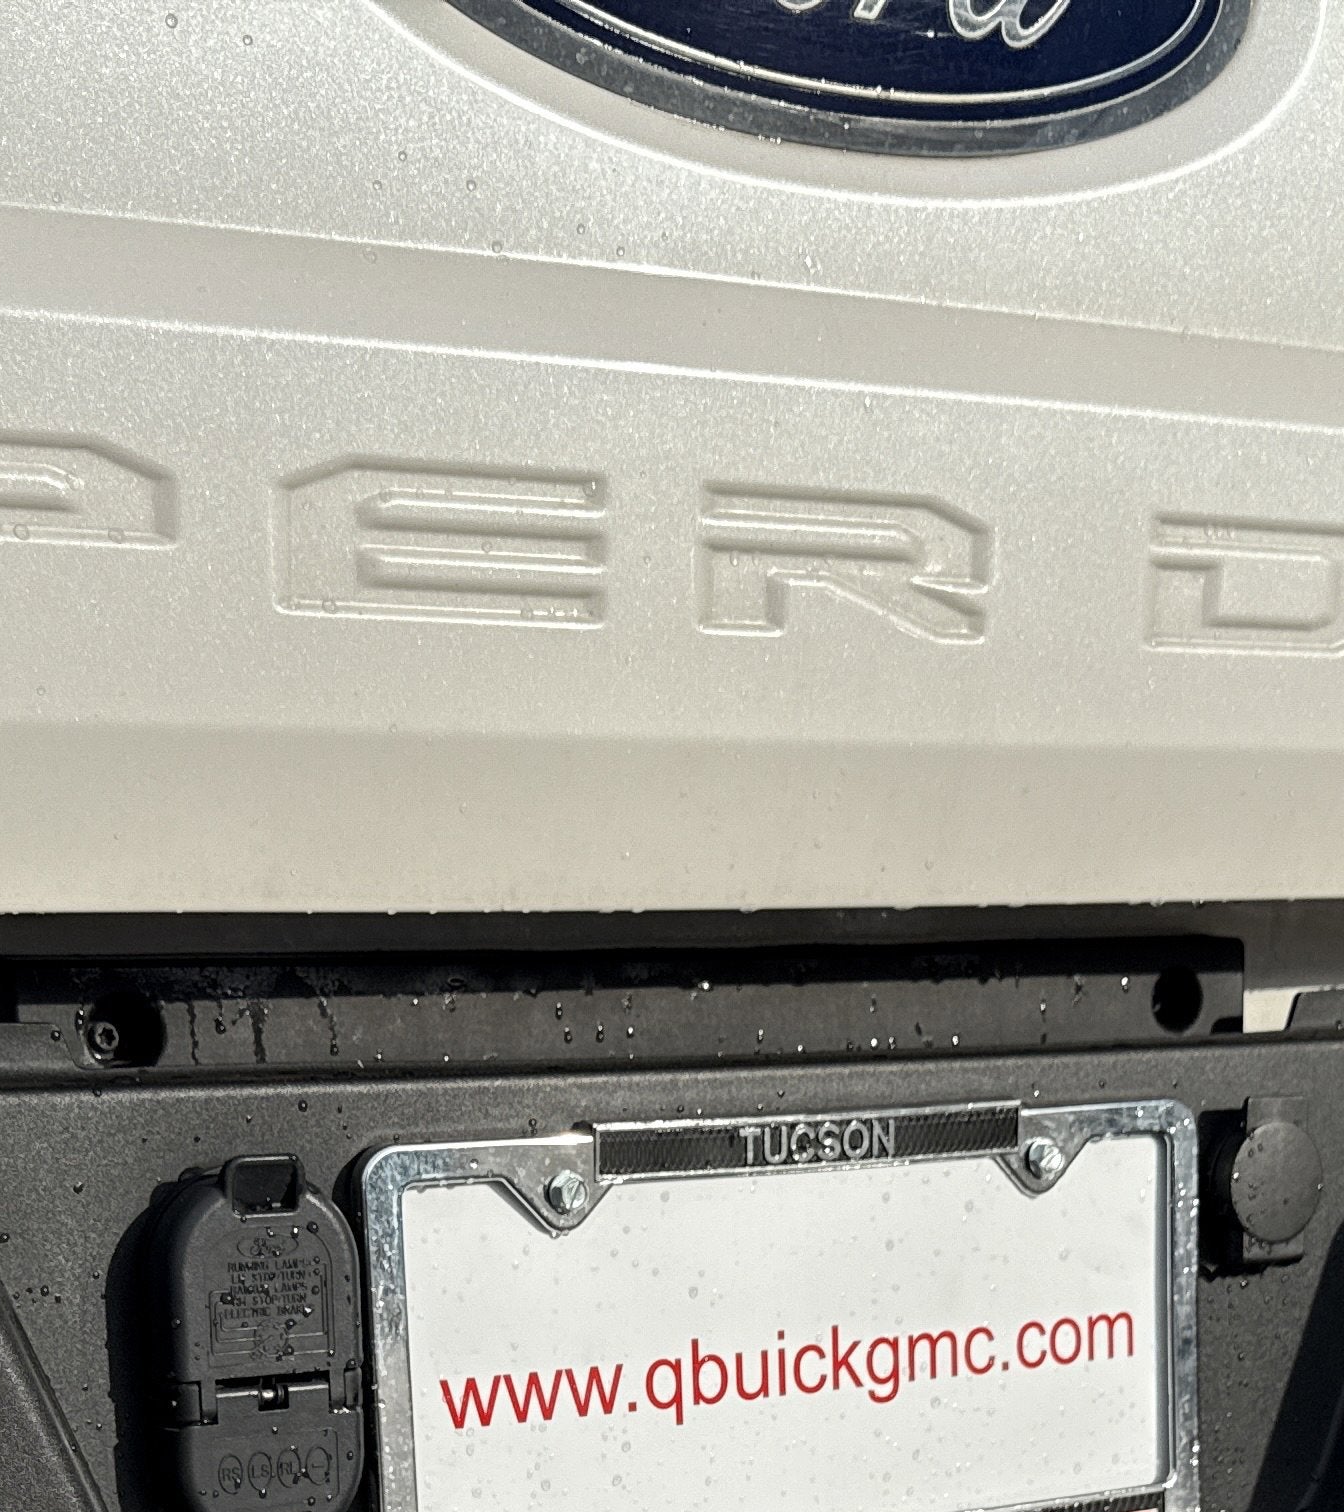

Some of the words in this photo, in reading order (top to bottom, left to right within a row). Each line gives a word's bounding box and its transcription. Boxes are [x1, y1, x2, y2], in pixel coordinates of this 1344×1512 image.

[739, 1119, 895, 1165] TUCSON
[440, 1310, 1135, 1430] www.qbuickgmc.com
[221, 1466, 241, 1482] RS
[250, 1464, 270, 1479] LS
